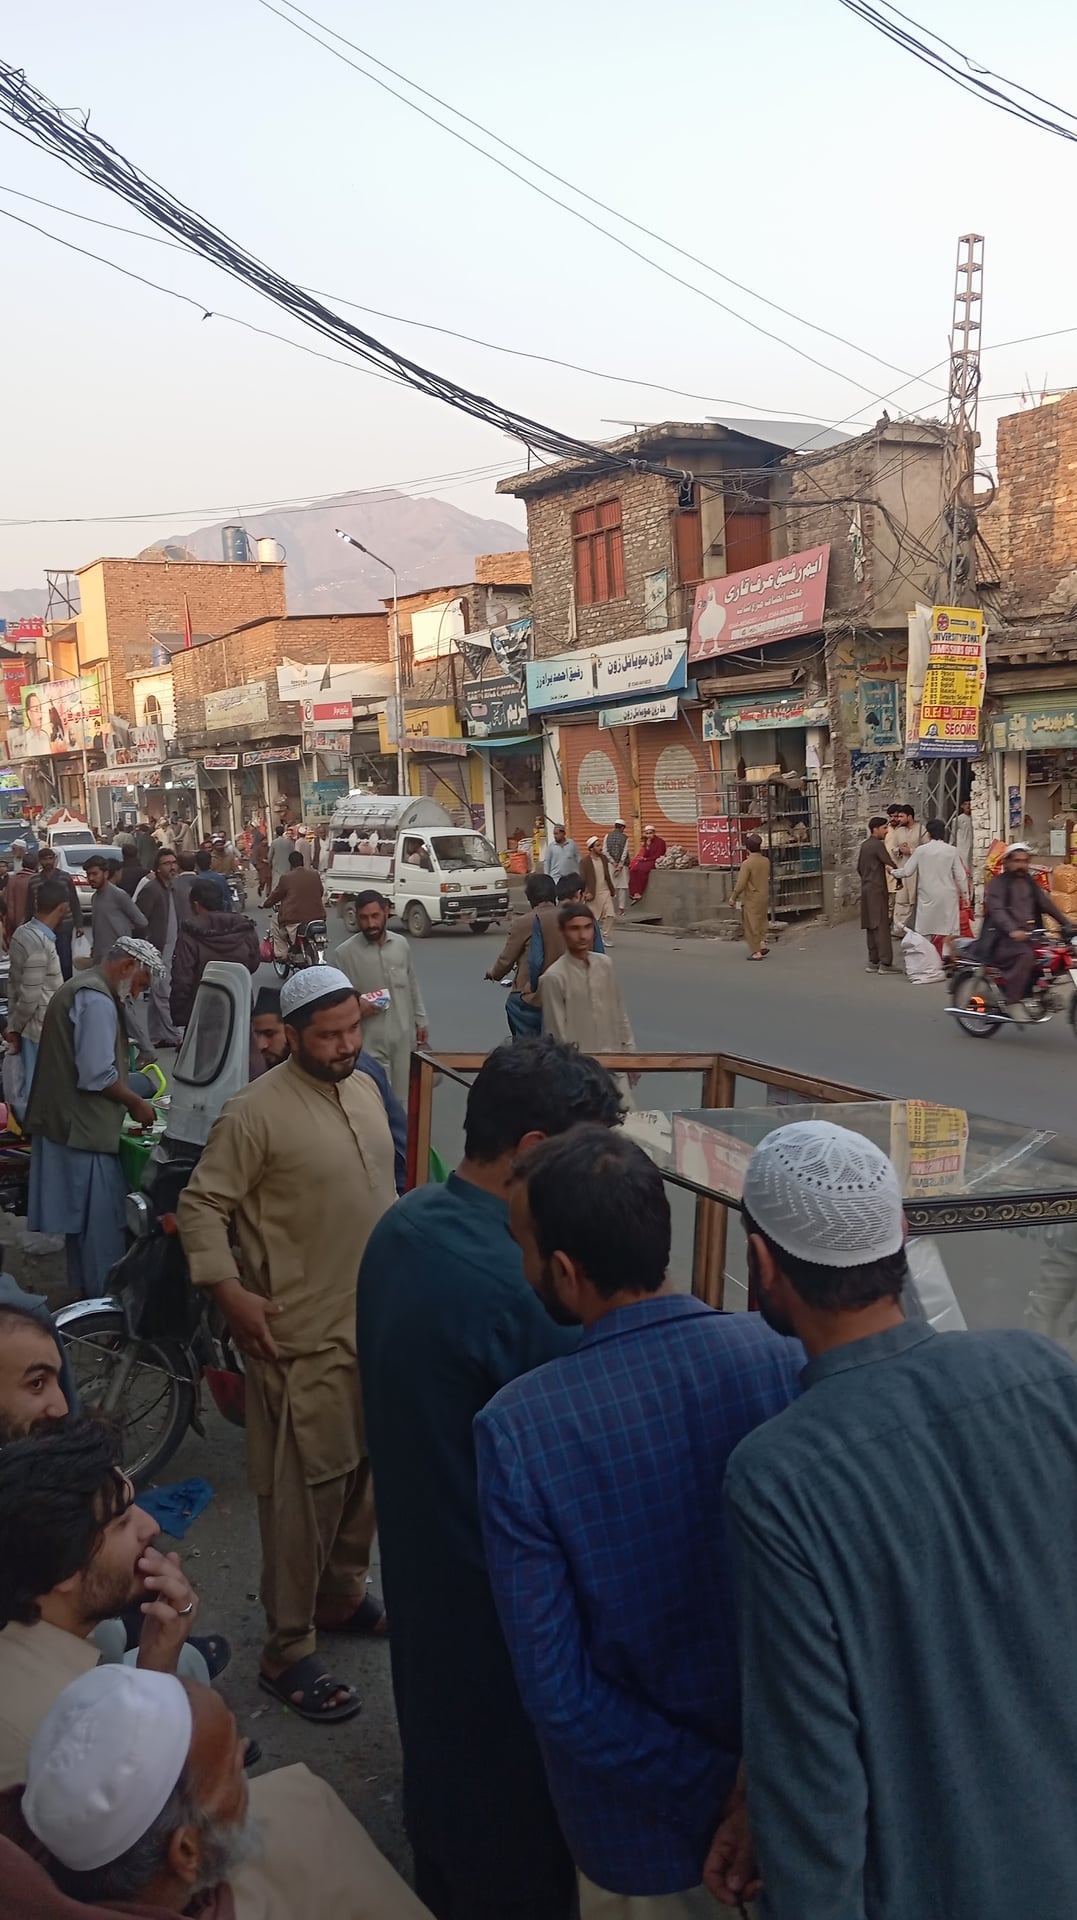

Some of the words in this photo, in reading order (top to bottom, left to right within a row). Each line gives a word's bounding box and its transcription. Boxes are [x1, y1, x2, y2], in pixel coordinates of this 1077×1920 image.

[750, 573, 774, 595] عرف
[774, 563, 803, 589] رفیق
[724, 577, 750, 603] قاری
[569, 665, 583, 682] رفیق
[945, 723, 976, 736] SECOMS
